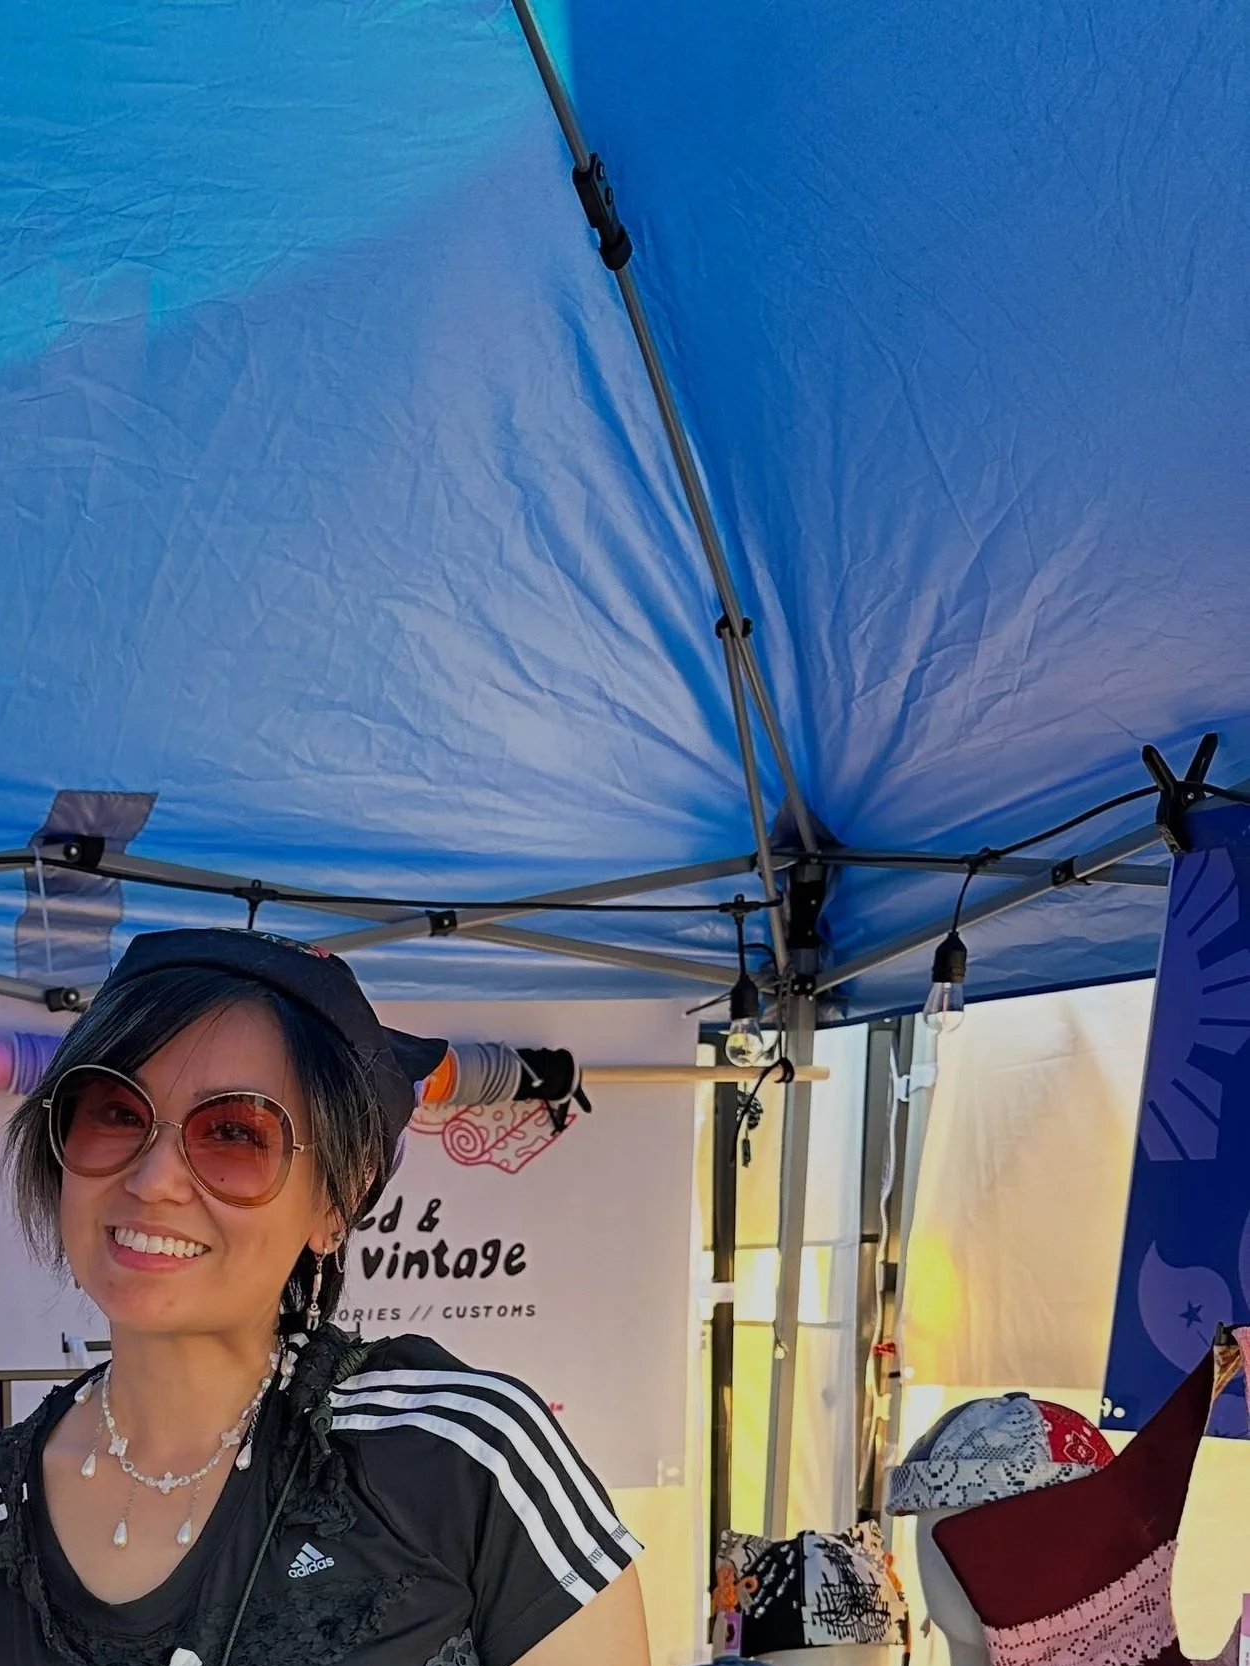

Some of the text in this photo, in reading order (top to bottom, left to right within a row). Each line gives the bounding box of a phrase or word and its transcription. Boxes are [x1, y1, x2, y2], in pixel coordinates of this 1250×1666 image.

[417, 1198, 441, 1232] &
[361, 1239, 526, 1279] vintage
[332, 1308, 400, 1321] ORIES
[442, 1304, 536, 1319] CUSTOMS
[288, 1557, 335, 1578] adidas
